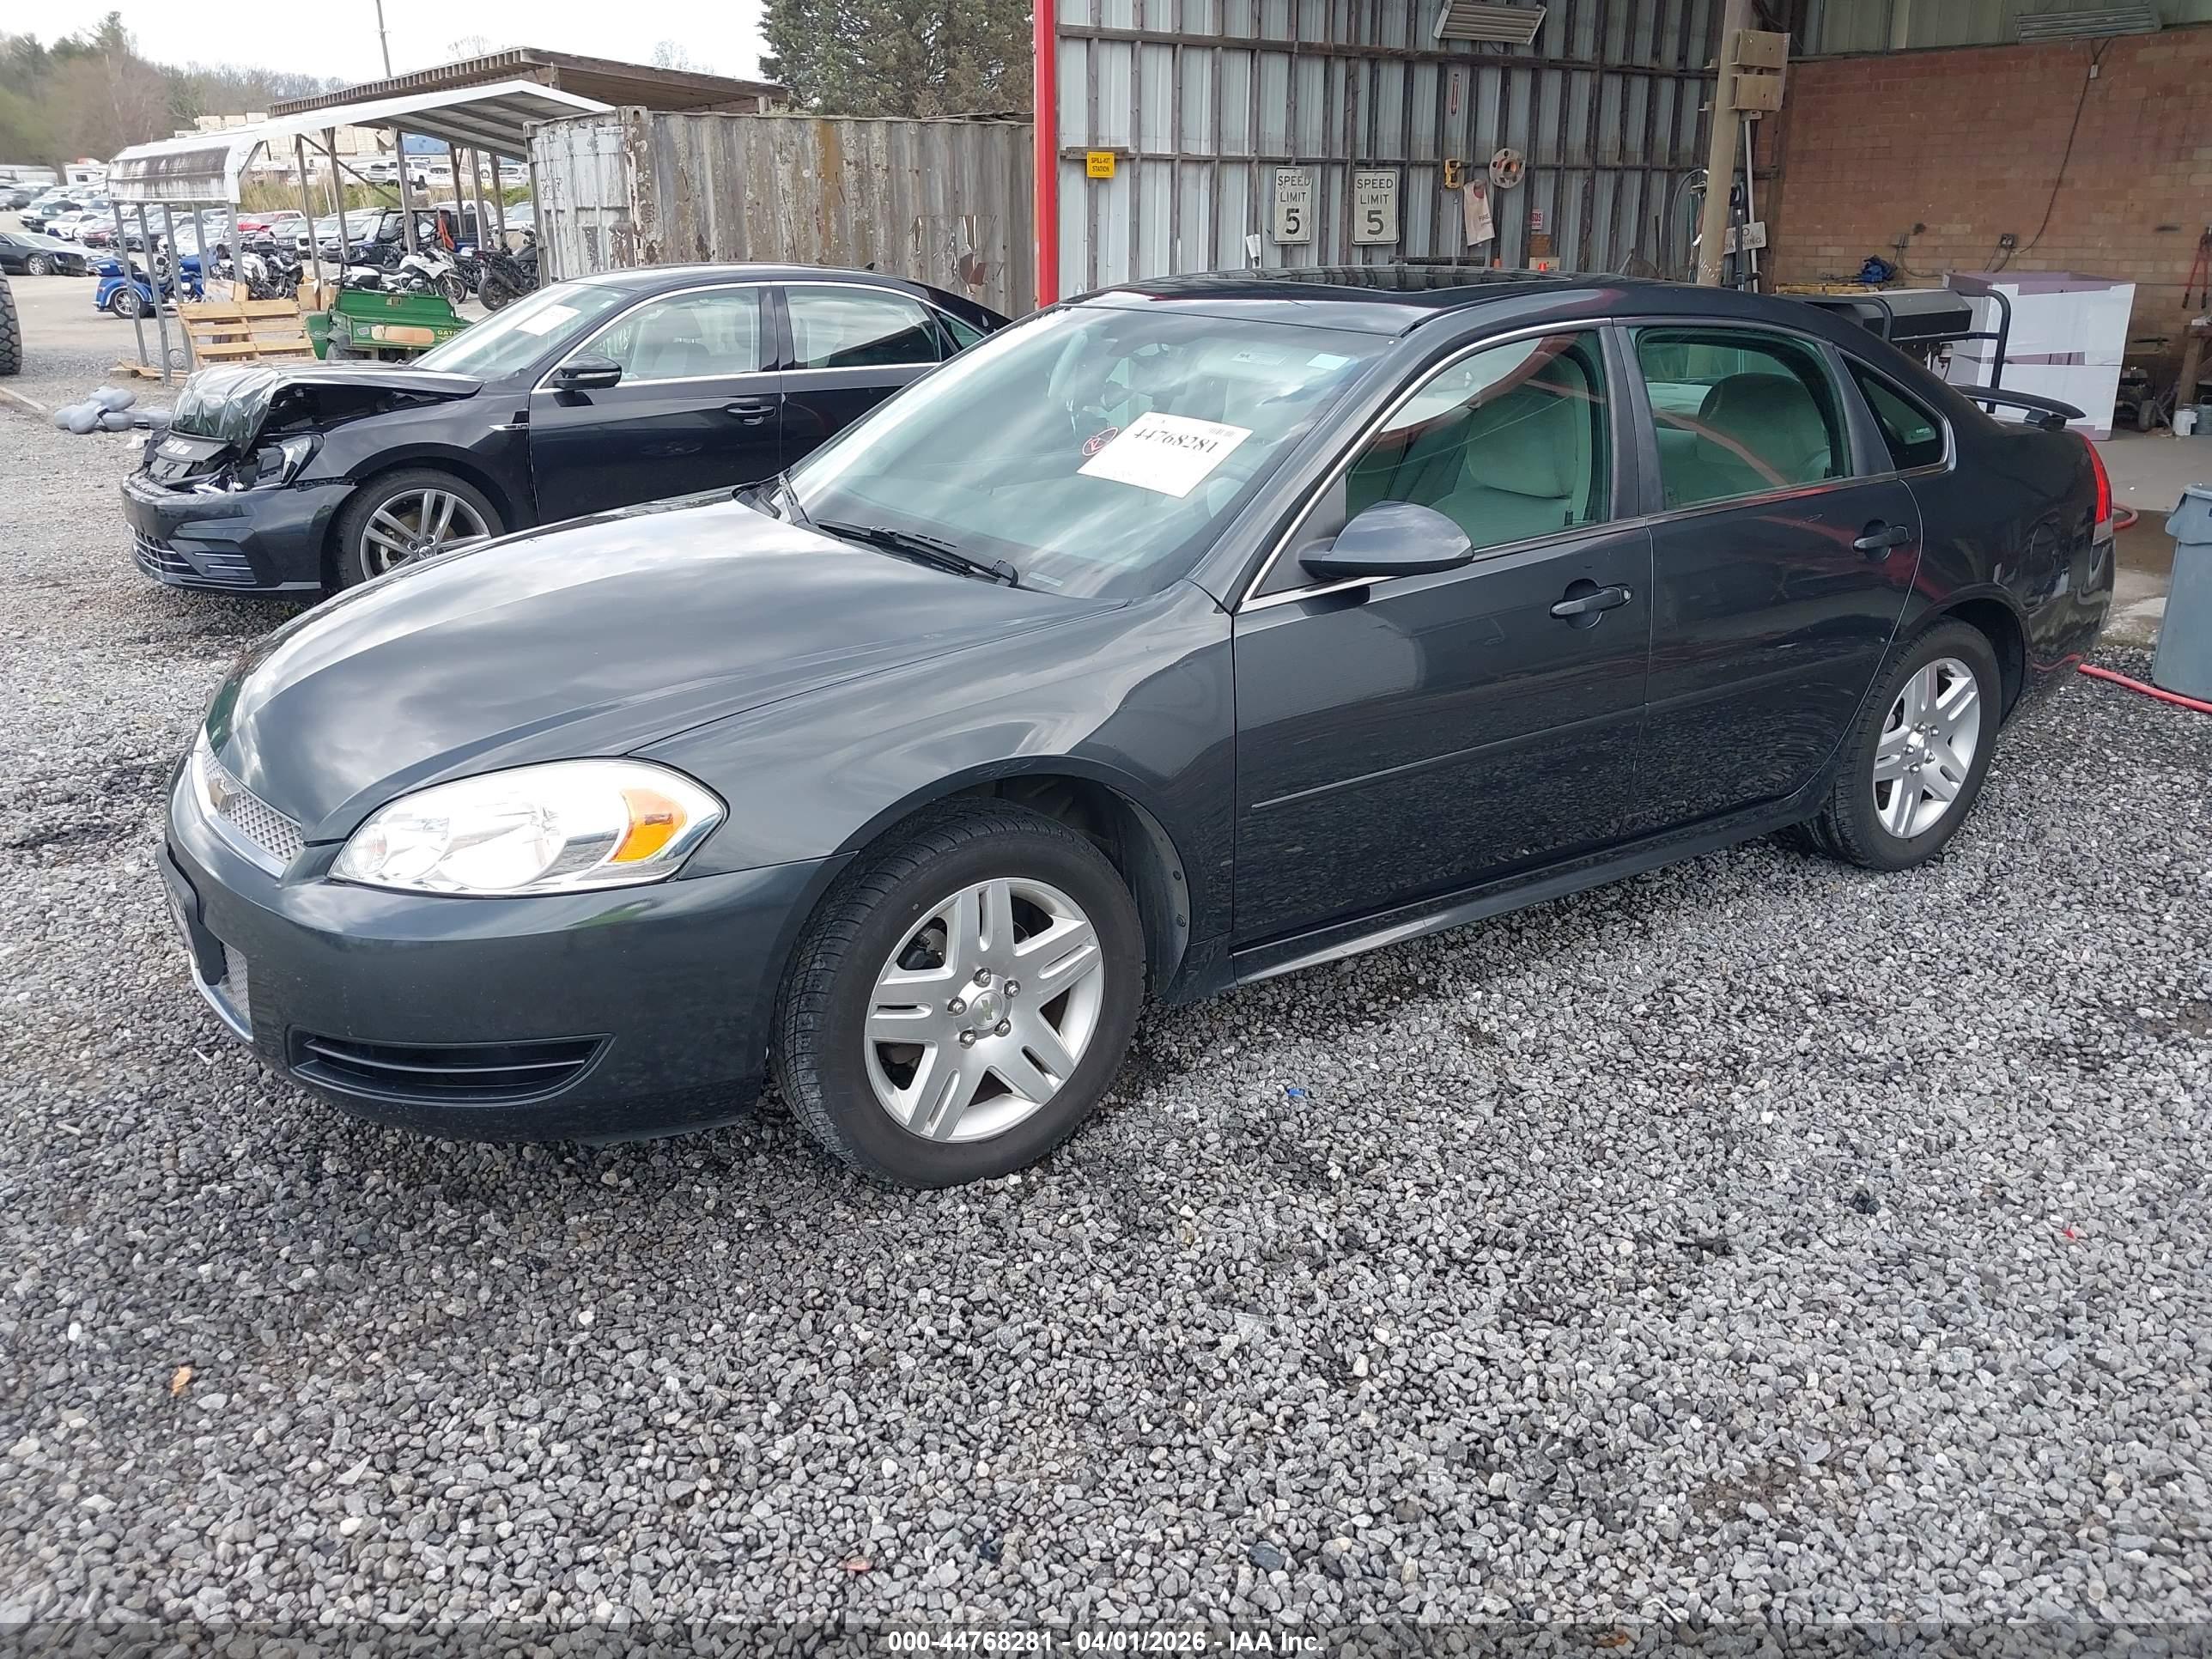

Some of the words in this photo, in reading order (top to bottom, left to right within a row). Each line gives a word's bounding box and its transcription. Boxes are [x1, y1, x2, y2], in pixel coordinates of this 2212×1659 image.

[1277, 175, 1311, 187] SPEED
[1356, 178, 1394, 190] SPEED
[1279, 191, 1307, 203] LIMIT
[1360, 194, 1389, 205] LIMIT
[1285, 208, 1300, 235] 5
[1367, 210, 1384, 235] 5
[1133, 428, 1218, 453] 44768281
